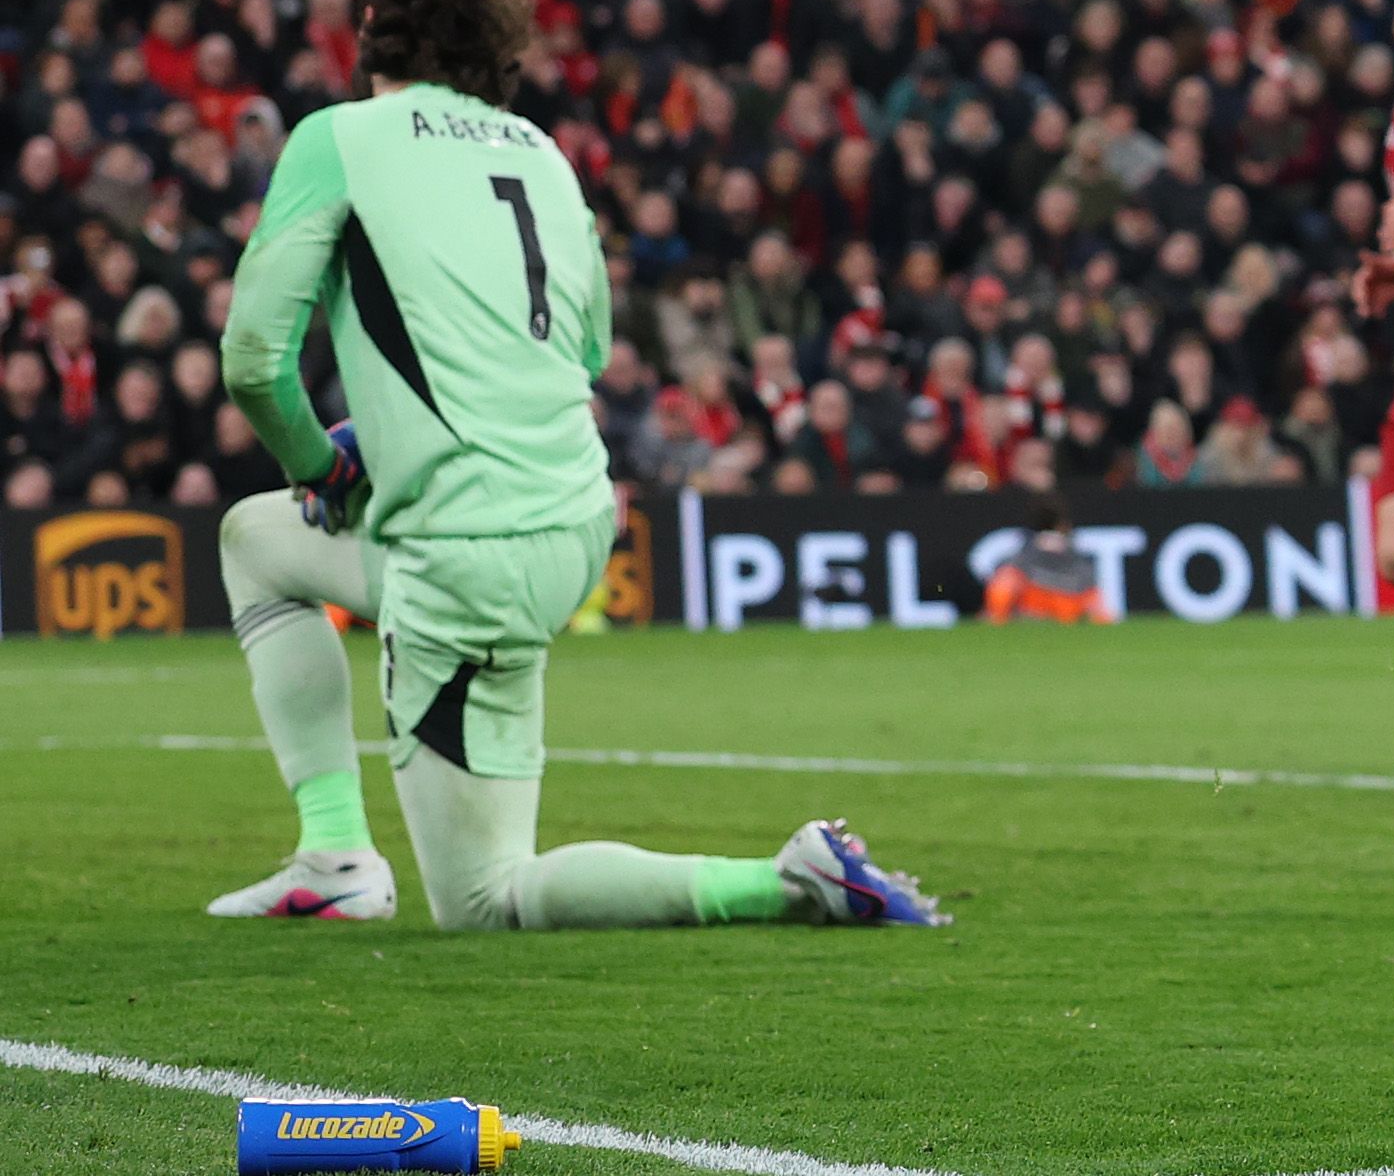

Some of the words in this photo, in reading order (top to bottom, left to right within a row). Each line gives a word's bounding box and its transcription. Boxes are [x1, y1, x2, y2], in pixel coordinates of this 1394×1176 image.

[489, 176, 550, 340] 1
[711, 523, 1349, 630] PELTON
[277, 1111, 406, 1140] Lucozade
